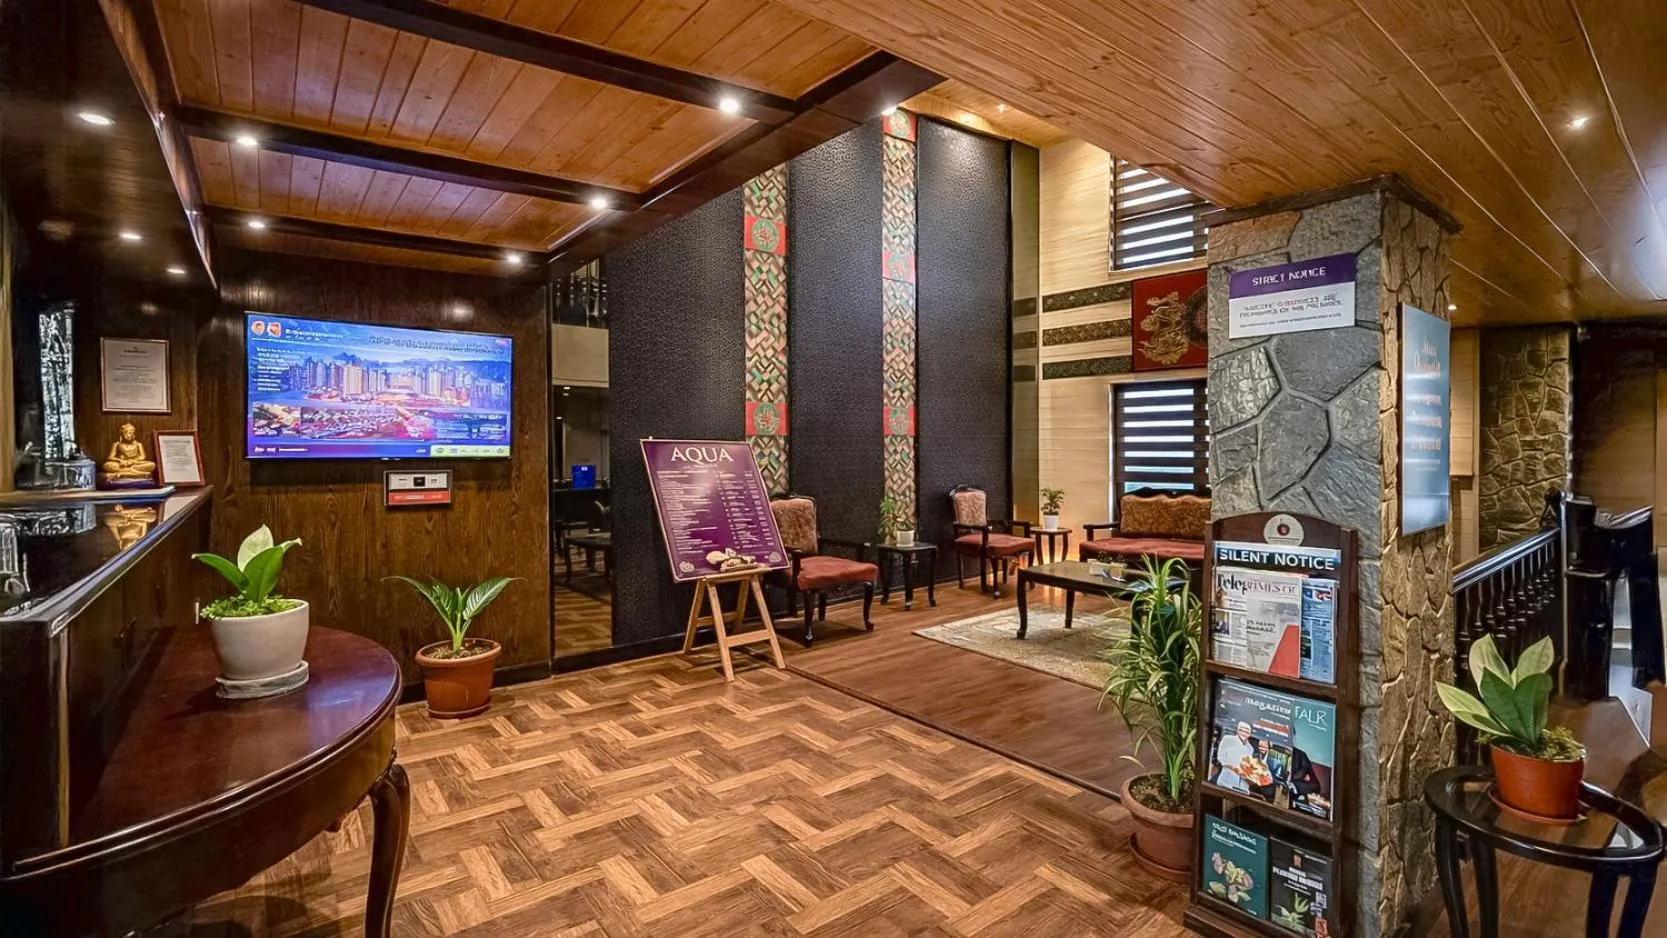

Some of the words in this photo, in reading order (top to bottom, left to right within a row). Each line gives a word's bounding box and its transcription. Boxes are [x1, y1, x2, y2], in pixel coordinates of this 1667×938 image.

[671, 446, 734, 465] AQUA
[1219, 548, 1270, 565] SILENT
[1274, 553, 1335, 571] NOTICE
